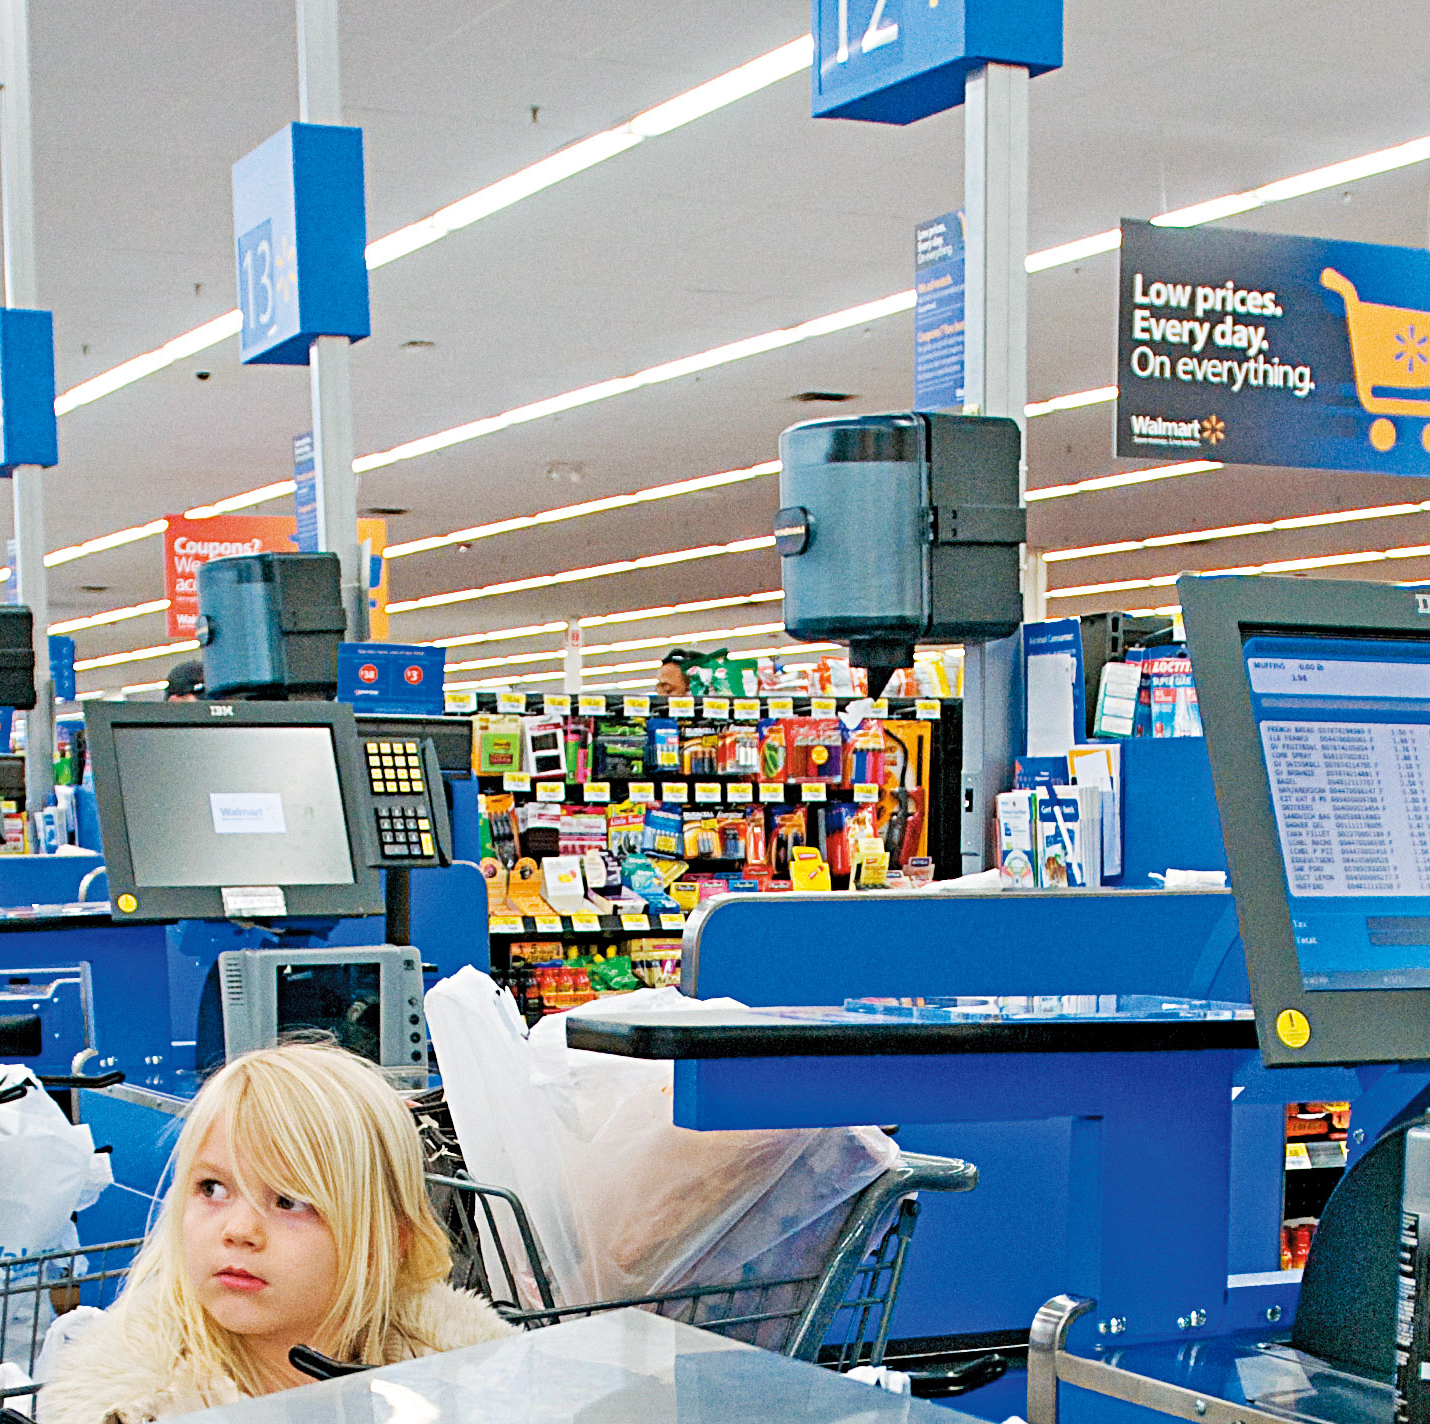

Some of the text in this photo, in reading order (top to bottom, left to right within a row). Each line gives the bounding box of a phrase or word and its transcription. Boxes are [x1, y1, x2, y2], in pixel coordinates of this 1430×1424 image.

[243, 240, 273, 329] 13
[1133, 273, 1283, 318] Low prices.
[1132, 309, 1270, 357] Every day.
[1130, 345, 1316, 399] On everything.
[1130, 414, 1201, 439] Walmart
[173, 536, 262, 556] Coupons?
[1151, 660, 1192, 674] LOCTIT
[219, 807, 263, 817] Walmart
